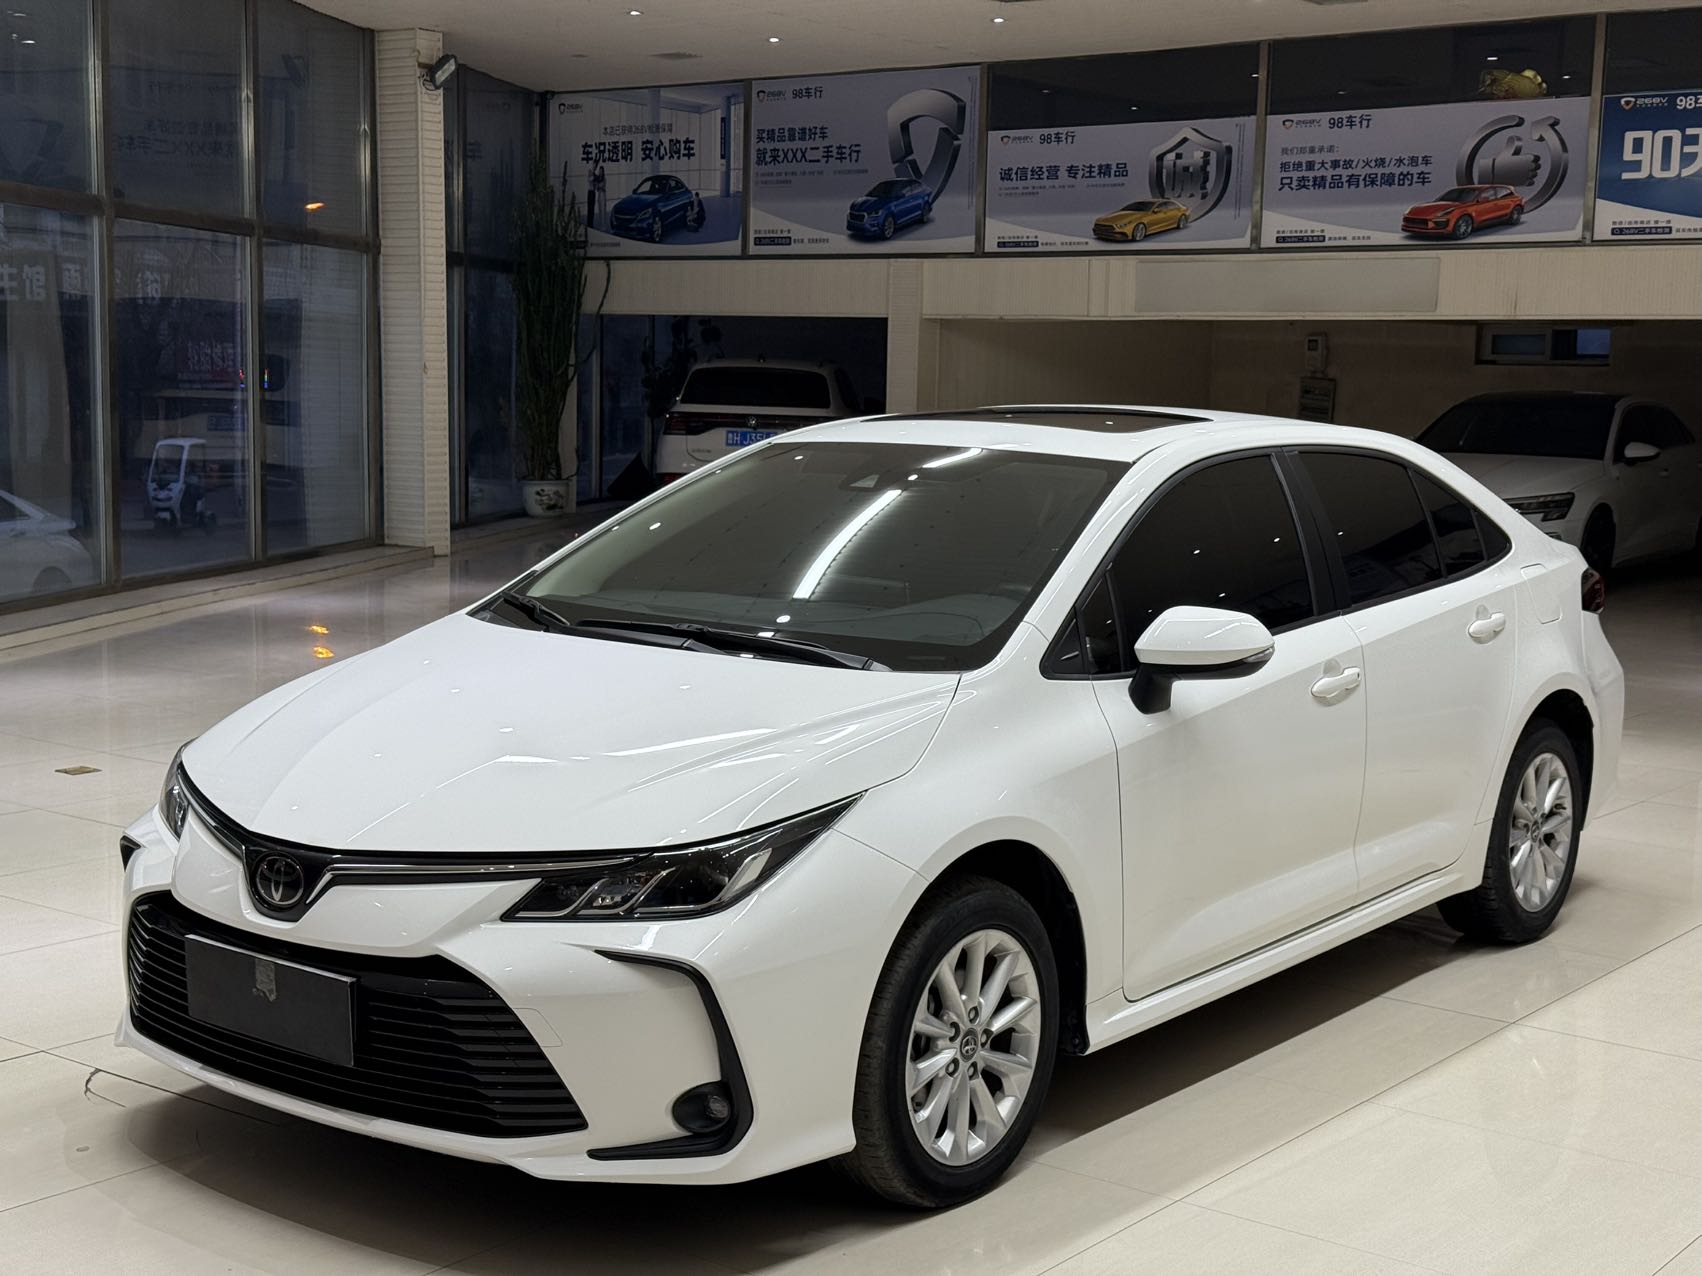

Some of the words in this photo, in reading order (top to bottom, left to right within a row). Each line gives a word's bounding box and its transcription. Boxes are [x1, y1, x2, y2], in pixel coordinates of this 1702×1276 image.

[792, 86, 824, 99] 98车行
[1636, 96, 1669, 104] 268V
[1328, 114, 1372, 130] 98车行
[1039, 131, 1076, 145] 98车行
[581, 140, 633, 163] 车况透明
[641, 137, 696, 162] 安心购车
[755, 144, 862, 166] 就来XXX二手车行
[999, 165, 1061, 183] 诚信经营
[1065, 162, 1129, 180] 专注精品
[1279, 155, 1433, 173] 拒绝重大事故/火烧/水泡车
[1278, 171, 1432, 191] 只卖精品有保障的车
